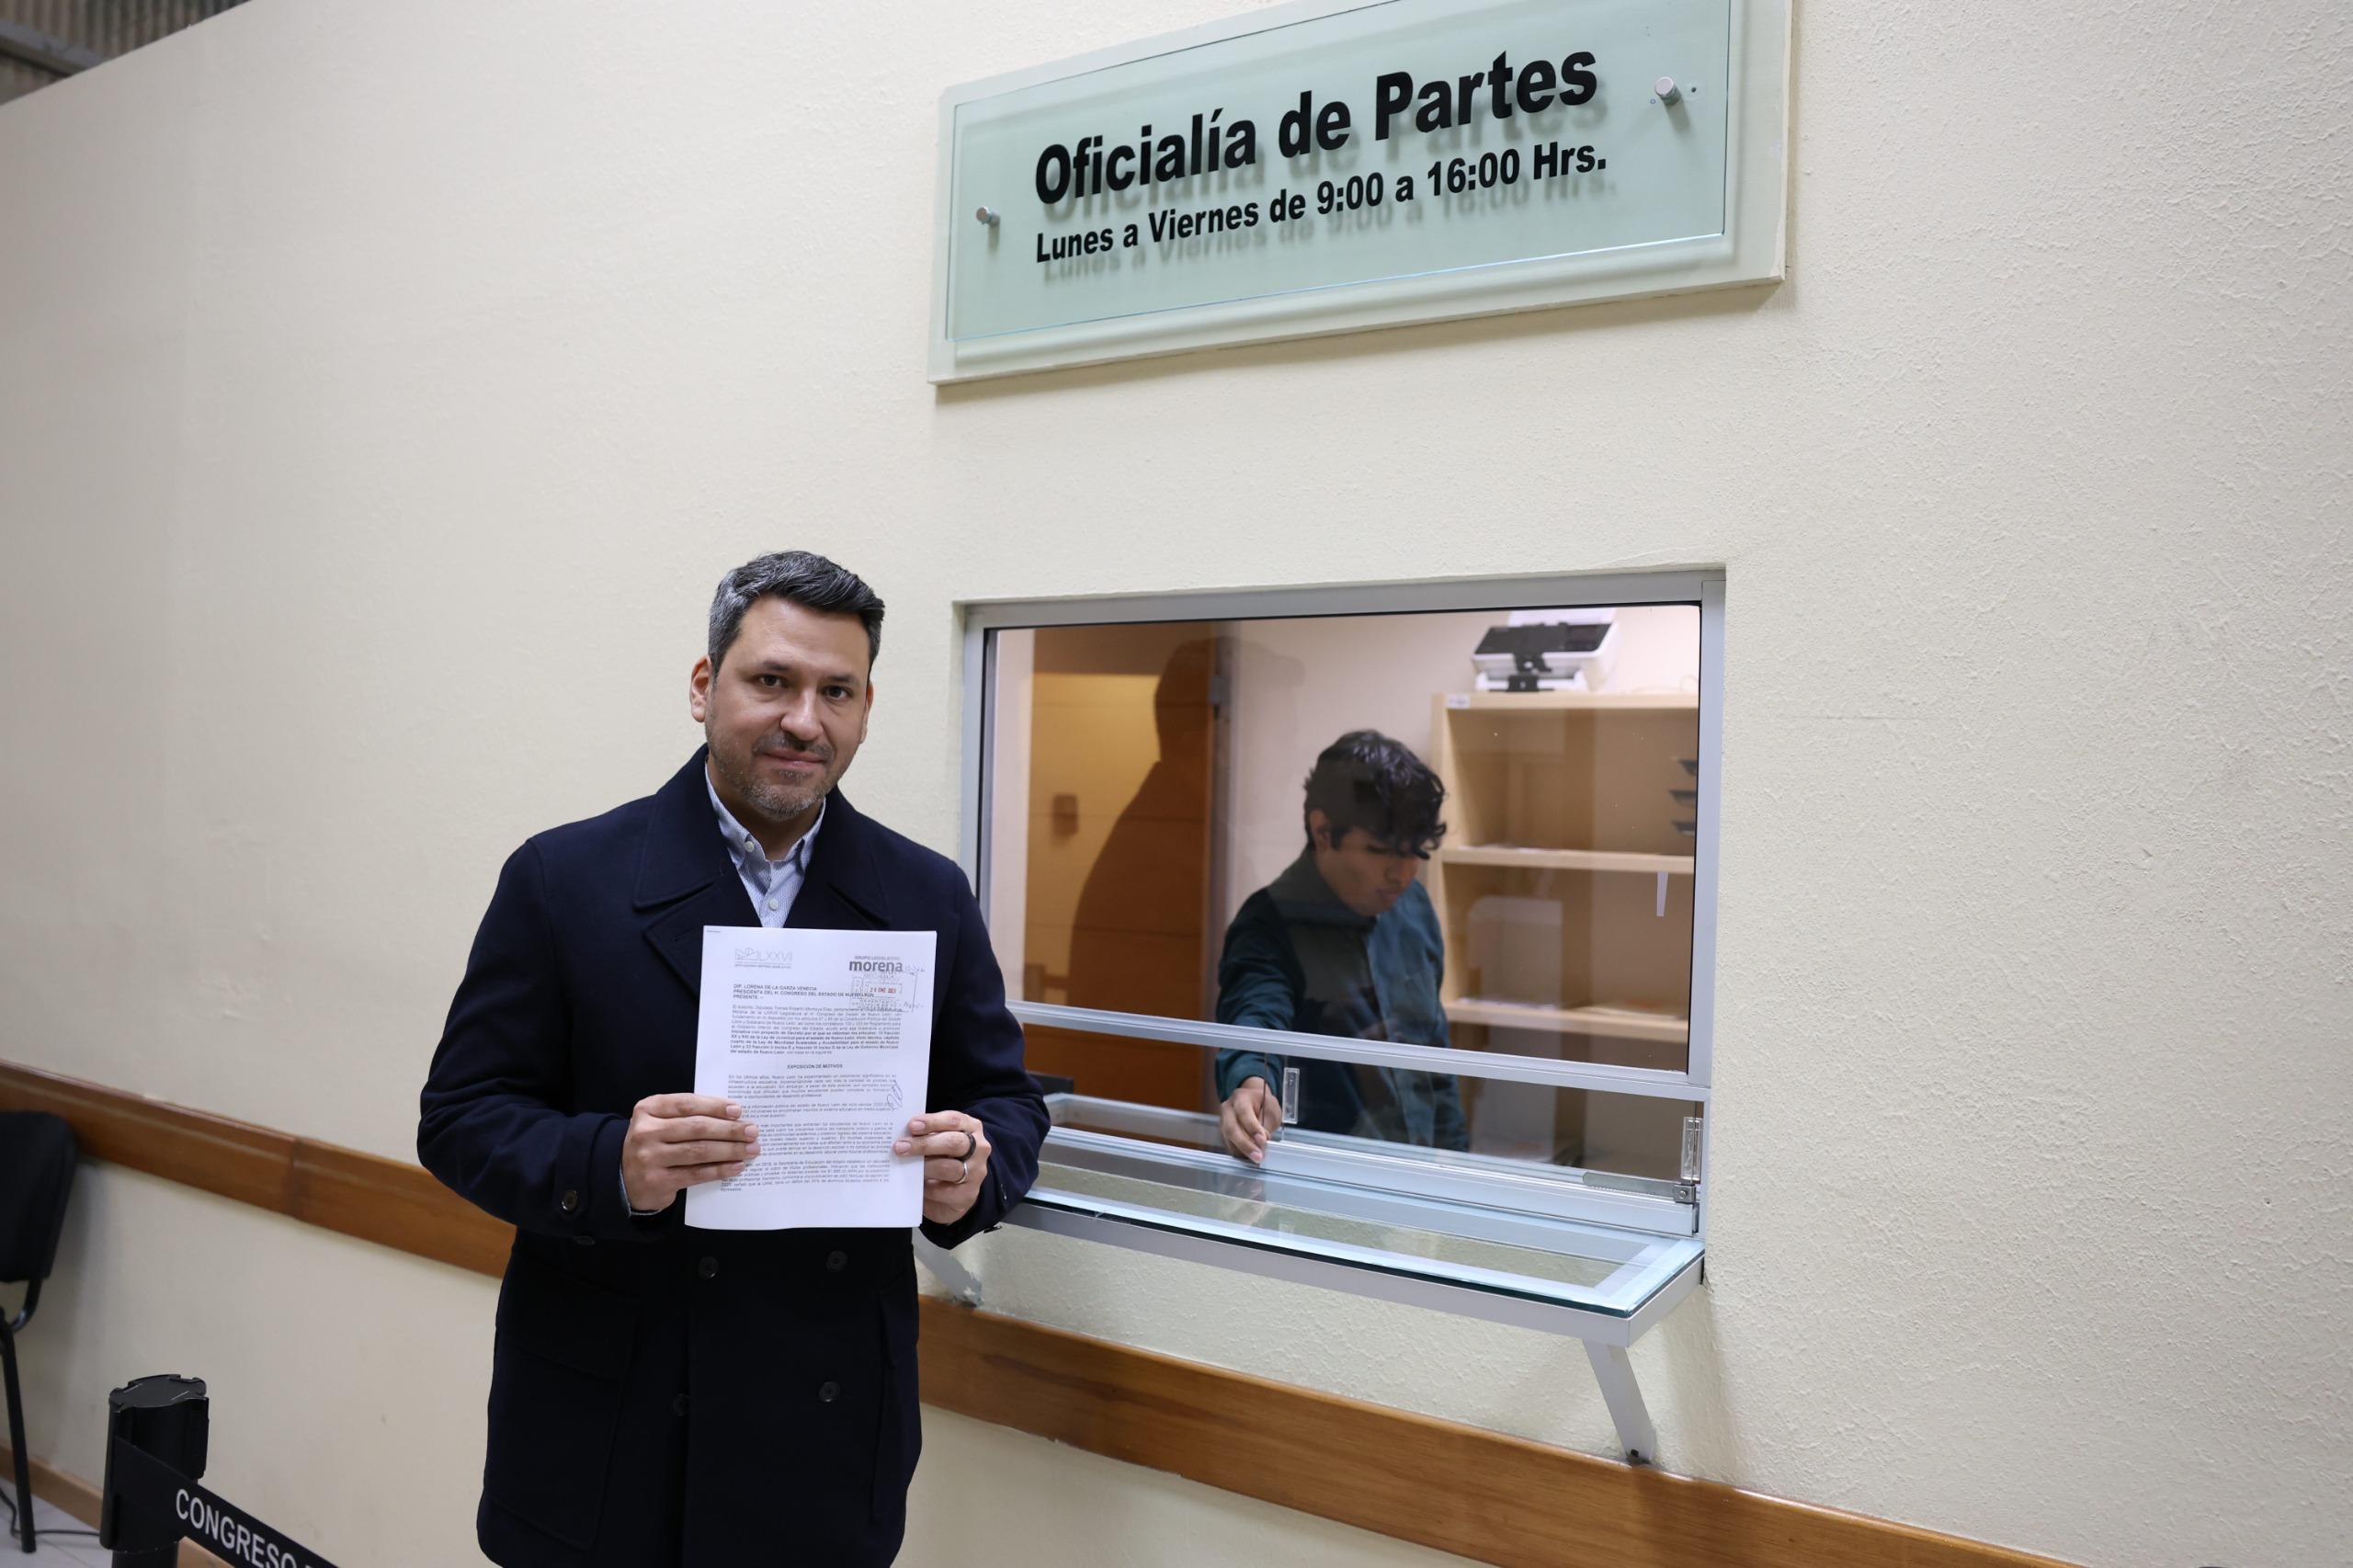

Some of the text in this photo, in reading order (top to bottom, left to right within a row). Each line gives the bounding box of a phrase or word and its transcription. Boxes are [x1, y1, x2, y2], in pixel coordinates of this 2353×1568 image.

[1035, 51, 1597, 204] Oficialía de Partes
[1037, 142, 1607, 263] Lunes a Viernes de 9:00 a 16:00 Hrs.
[849, 960, 904, 972] morena
